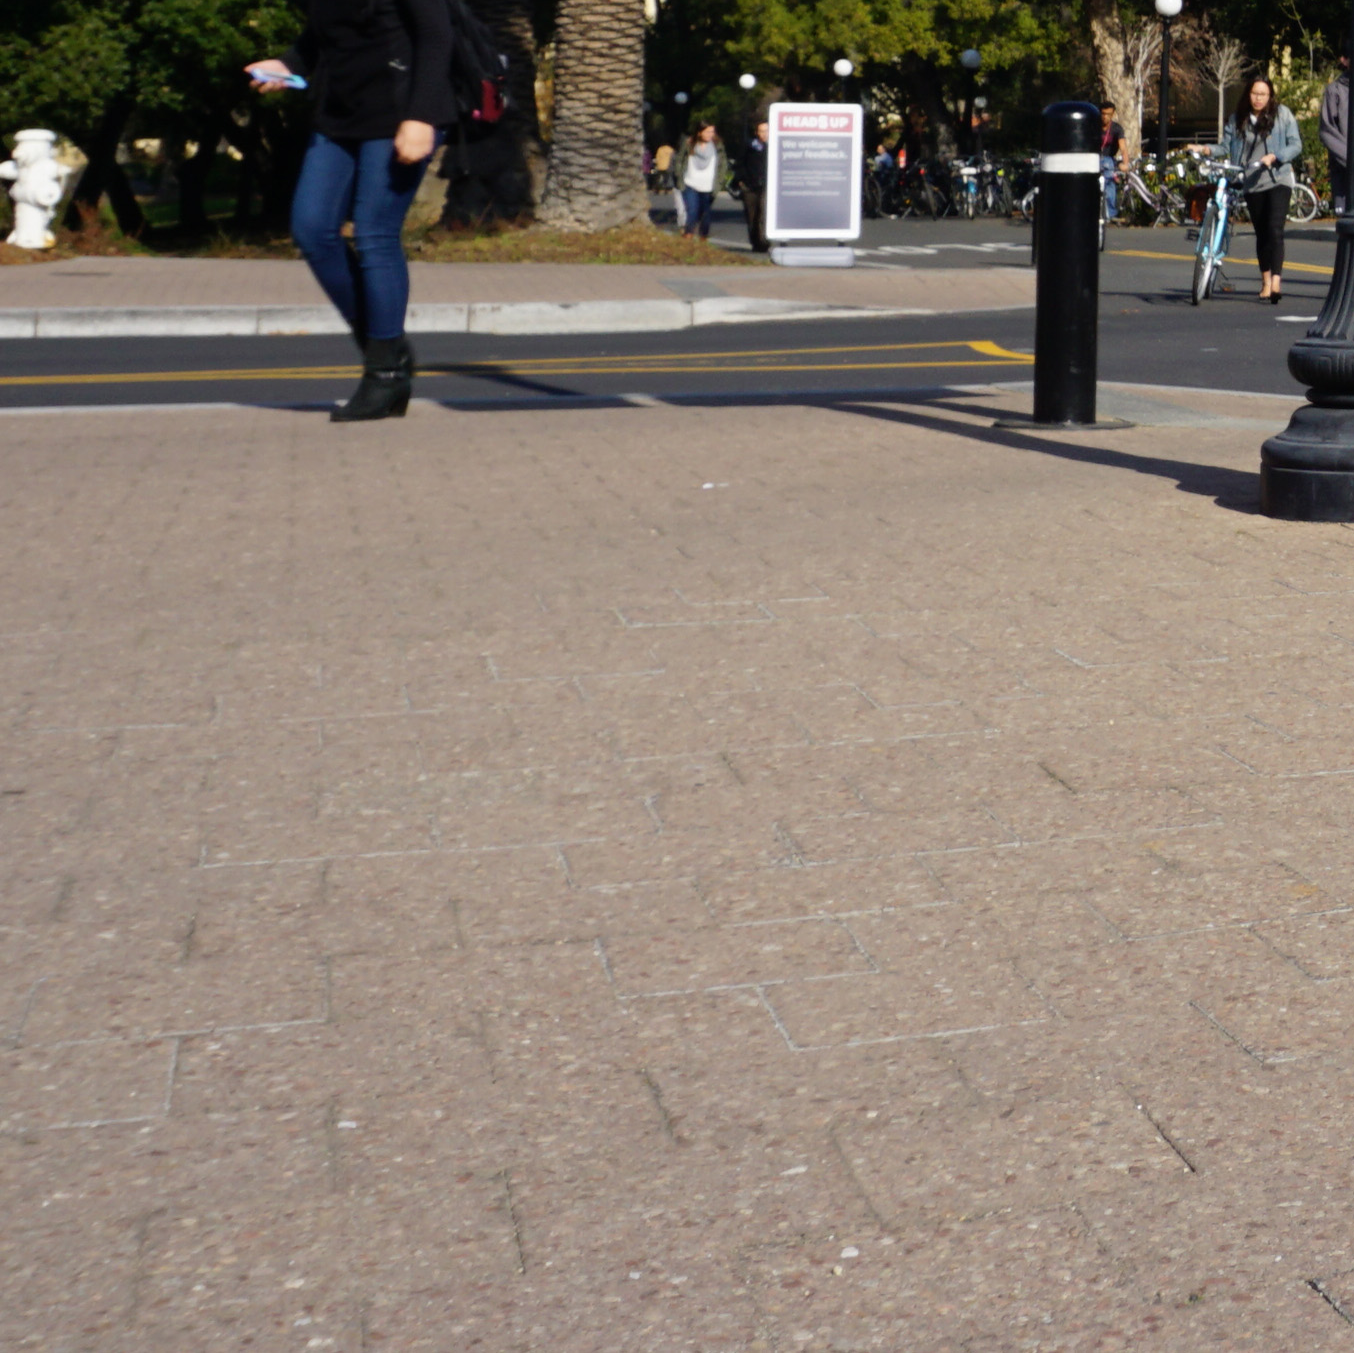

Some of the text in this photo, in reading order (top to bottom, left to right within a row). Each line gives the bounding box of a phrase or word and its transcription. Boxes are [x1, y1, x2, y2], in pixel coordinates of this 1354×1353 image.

[782, 115, 849, 129] HEADS UP
[782, 140, 839, 149] We welcome
[782, 151, 803, 161] your
